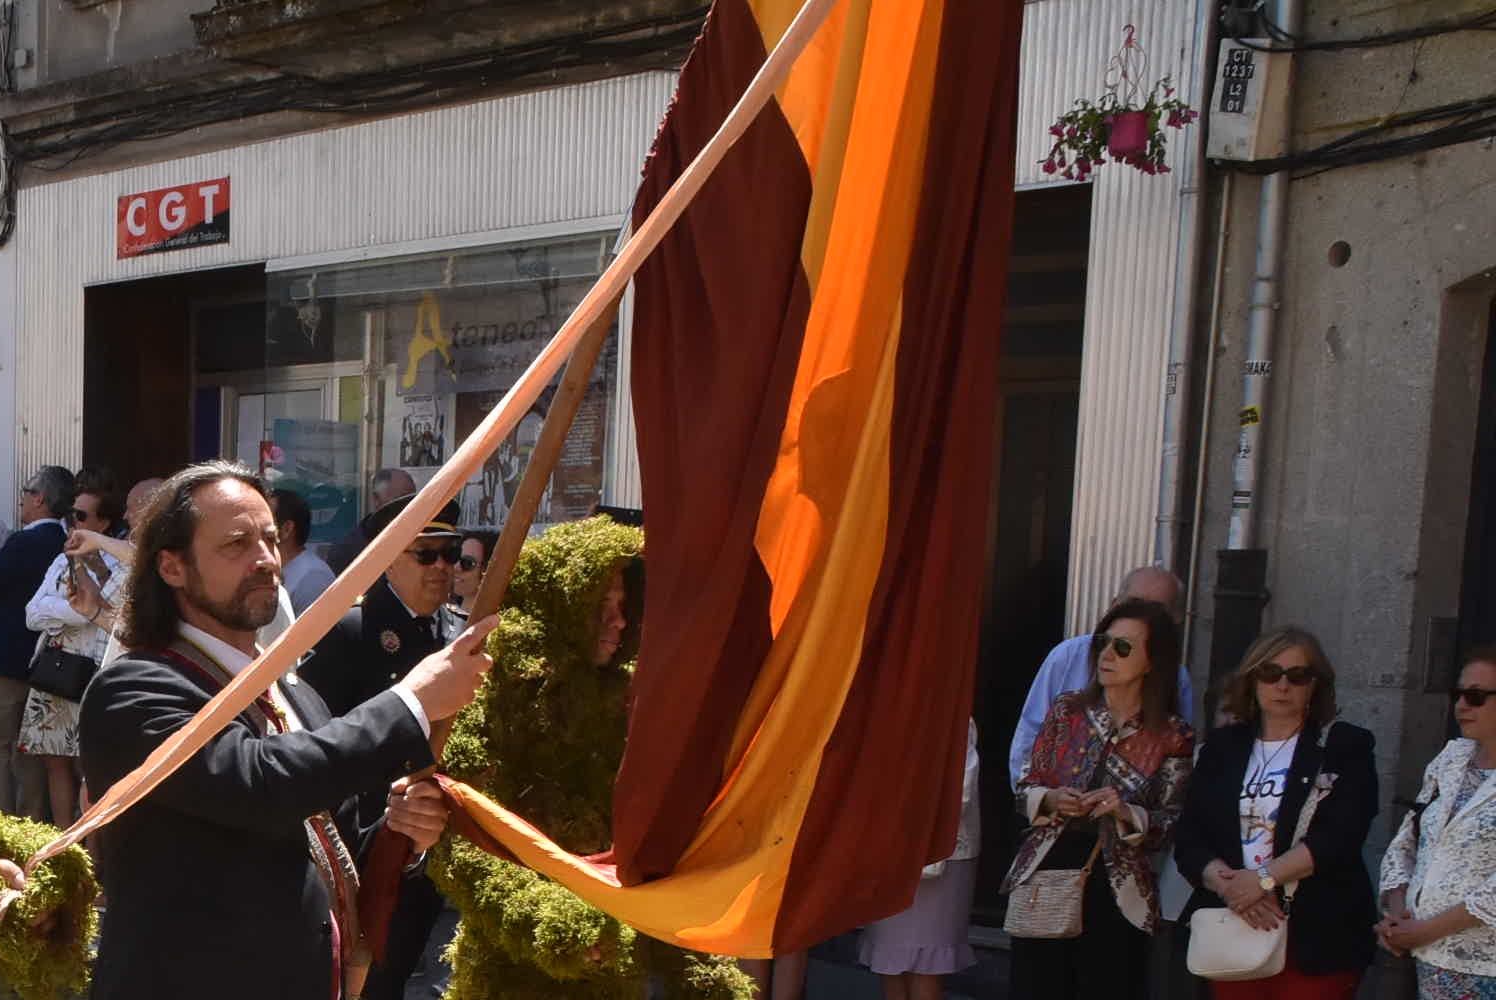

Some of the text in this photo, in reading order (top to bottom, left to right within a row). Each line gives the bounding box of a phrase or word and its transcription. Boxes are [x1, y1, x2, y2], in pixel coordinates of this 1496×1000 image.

[1233, 50, 1249, 61] CT
[1224, 65, 1254, 77] 1237
[1229, 84, 1242, 96] L2
[127, 184, 220, 236] CGT
